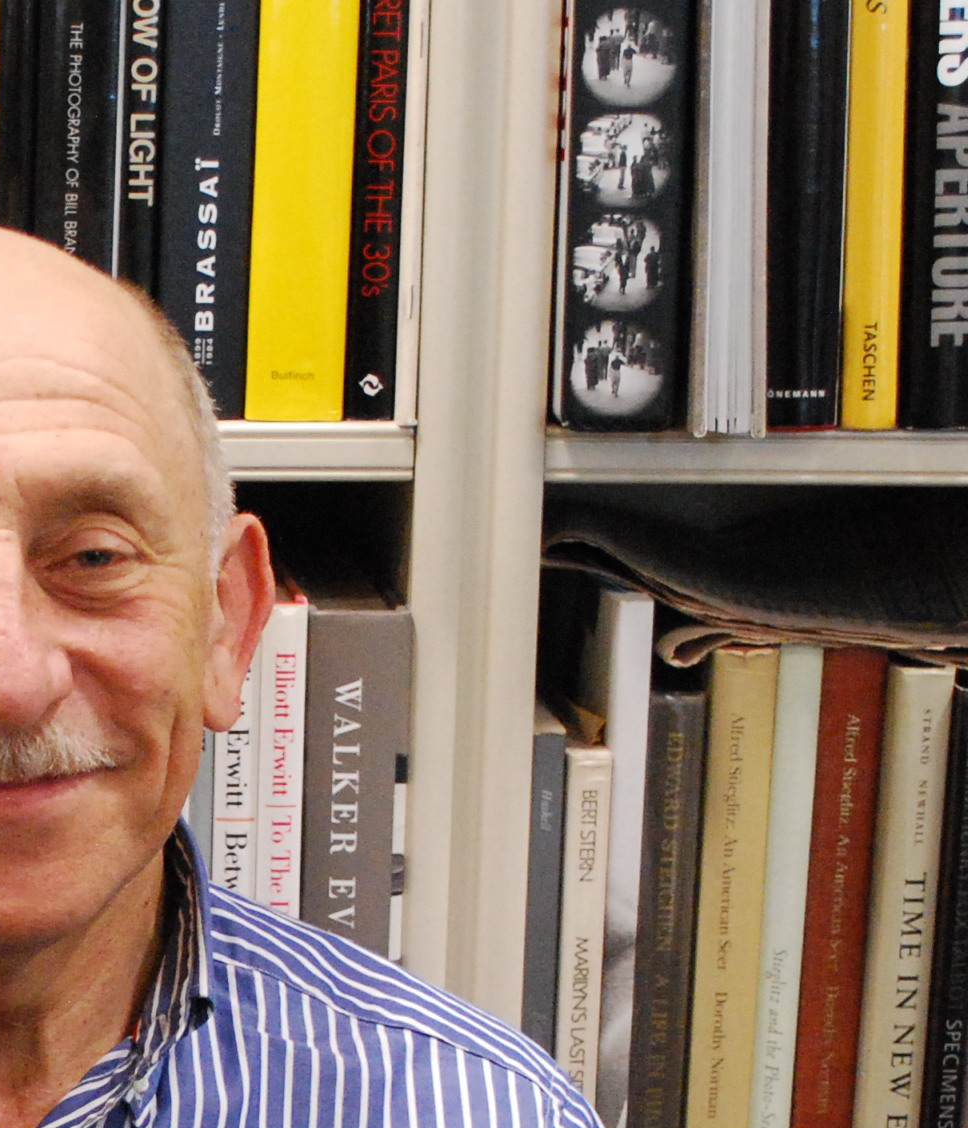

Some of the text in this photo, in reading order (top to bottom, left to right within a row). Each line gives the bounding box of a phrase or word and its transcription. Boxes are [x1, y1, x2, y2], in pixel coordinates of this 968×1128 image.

[131, 57, 158, 105] OF
[368, 49, 400, 122] PARIS
[64, 23, 83, 216] THE PHOTOGRAPHY OF BILL
[128, 114, 156, 206] LIGHT
[367, 130, 397, 172] OF
[364, 181, 394, 233] THE
[930, 102, 968, 348] APERTURE
[194, 157, 220, 332] BRASSAÏ
[362, 244, 390, 297] 30's
[270, 370, 315, 381] Bulfinch
[861, 322, 878, 402] TASCHEN
[274, 652, 297, 718] Elliott
[272, 727, 295, 798] Erwitt
[328, 677, 364, 856] WALKER
[730, 712, 745, 764] Alfred
[846, 713, 862, 762] Alfred
[919, 708, 932, 766] STRAND
[225, 729, 250, 810] Erwitt
[270, 815, 292, 844] To
[914, 779, 929, 846] NEWHALL
[270, 851, 292, 896] The
[724, 835, 738, 858] An
[569, 789, 599, 1067] BERT STERN MARILYN'S LAST
[719, 862, 736, 936] American
[898, 871, 928, 961] TIME
[716, 939, 731, 971] Seer
[708, 991, 728, 1052] Dorothy
[766, 1008, 783, 1036] and
[894, 974, 920, 1012] IN
[766, 1039, 782, 1061] the
[888, 1023, 916, 1100] NEW
[707, 1056, 723, 1120] Norman
